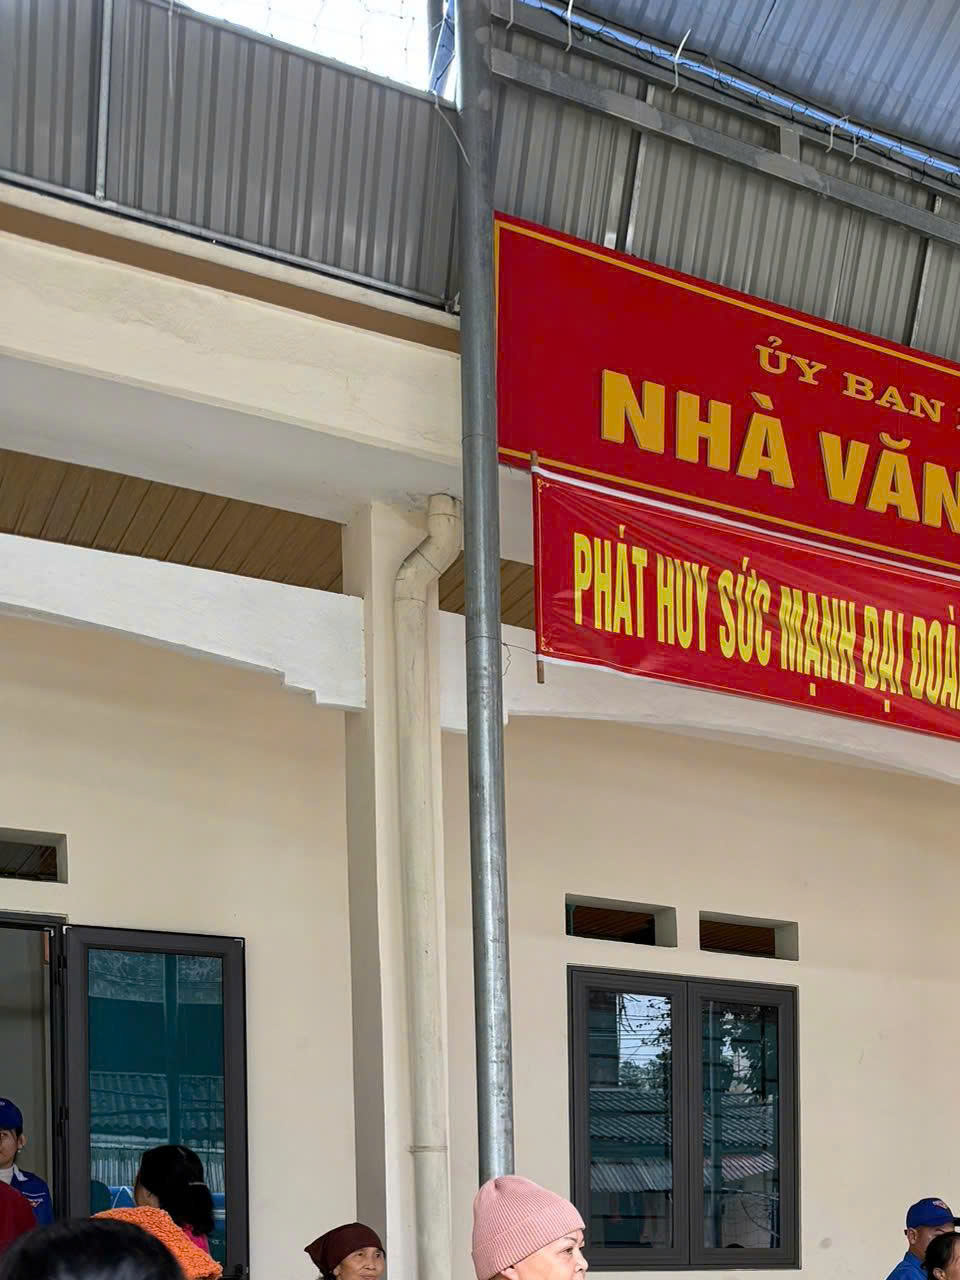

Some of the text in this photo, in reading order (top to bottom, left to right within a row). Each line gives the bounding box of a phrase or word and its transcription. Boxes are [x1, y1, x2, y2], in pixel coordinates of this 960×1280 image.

[601, 369, 795, 488] NHÀ
[755, 336, 826, 385] ỦY
[842, 372, 945, 423] BAN
[573, 524, 648, 638] PHÁT
[656, 553, 709, 652] HUY
[717, 556, 772, 667] SỨC
[779, 585, 856, 697] MẠNH
[862, 605, 905, 713] ĐẠI
